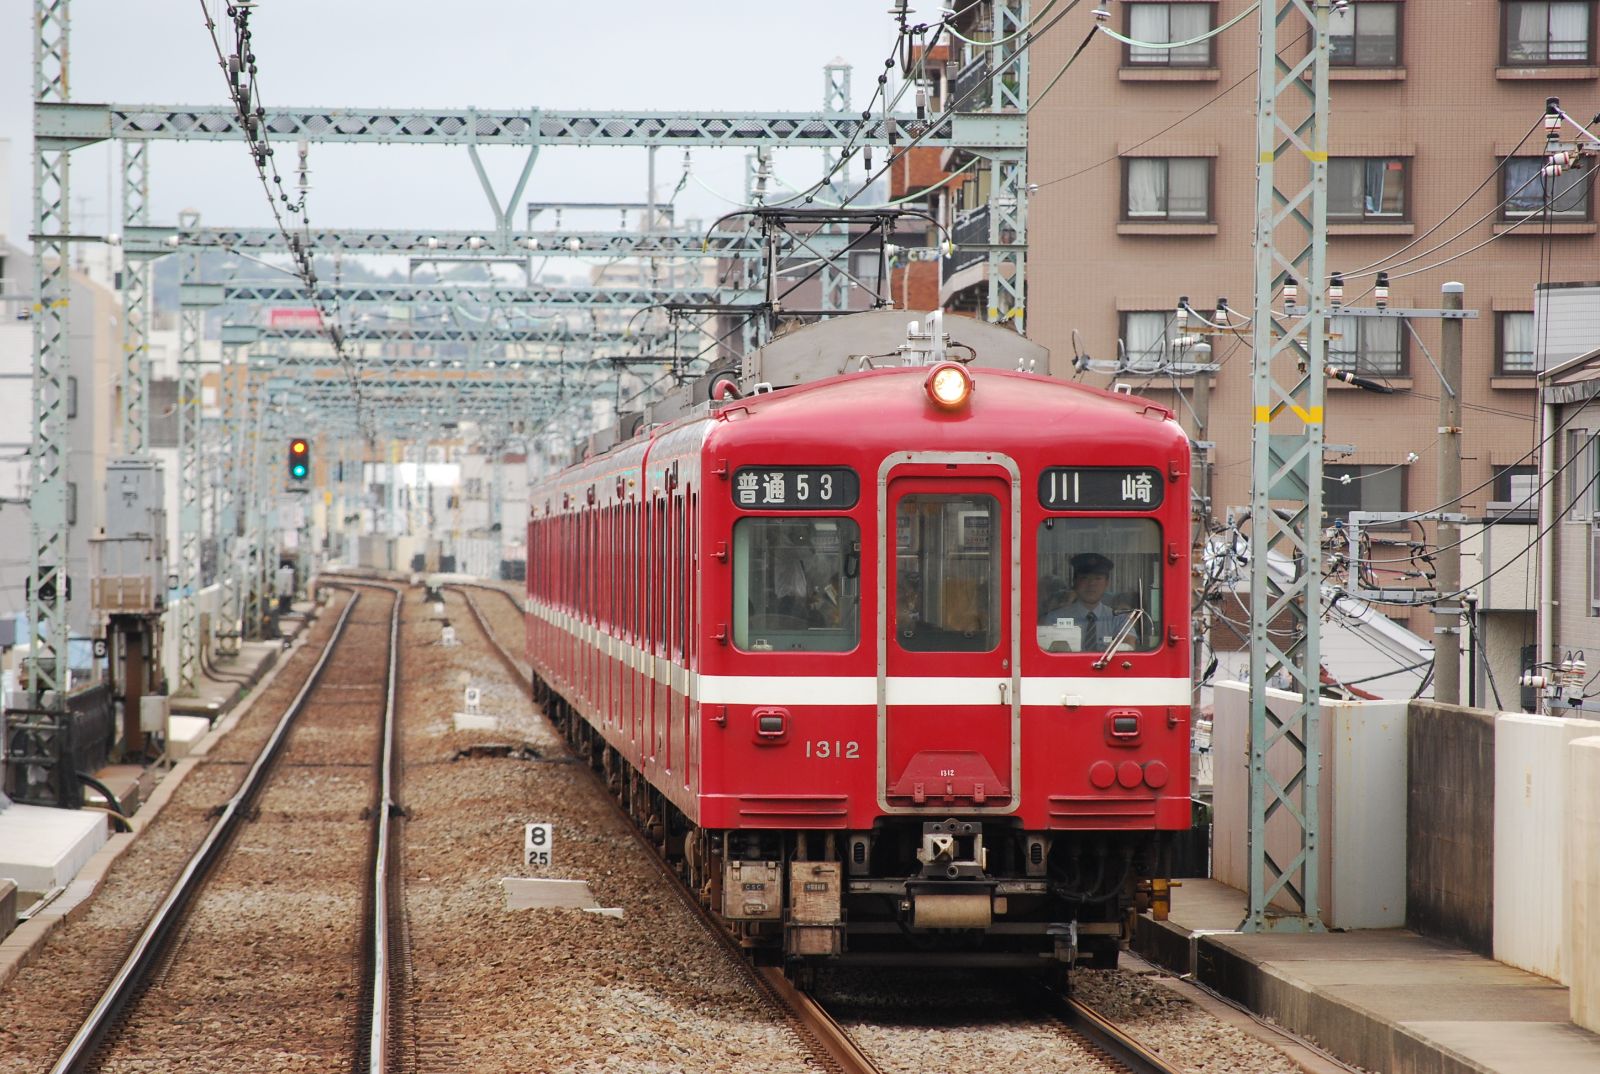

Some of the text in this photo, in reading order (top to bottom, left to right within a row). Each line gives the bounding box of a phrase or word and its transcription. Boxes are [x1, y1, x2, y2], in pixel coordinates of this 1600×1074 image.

[737, 472, 785, 503] 普通
[806, 740, 860, 759] 1312
[940, 769, 955, 777] 1312
[531, 826, 546, 846] 8
[529, 851, 548, 865] 25
